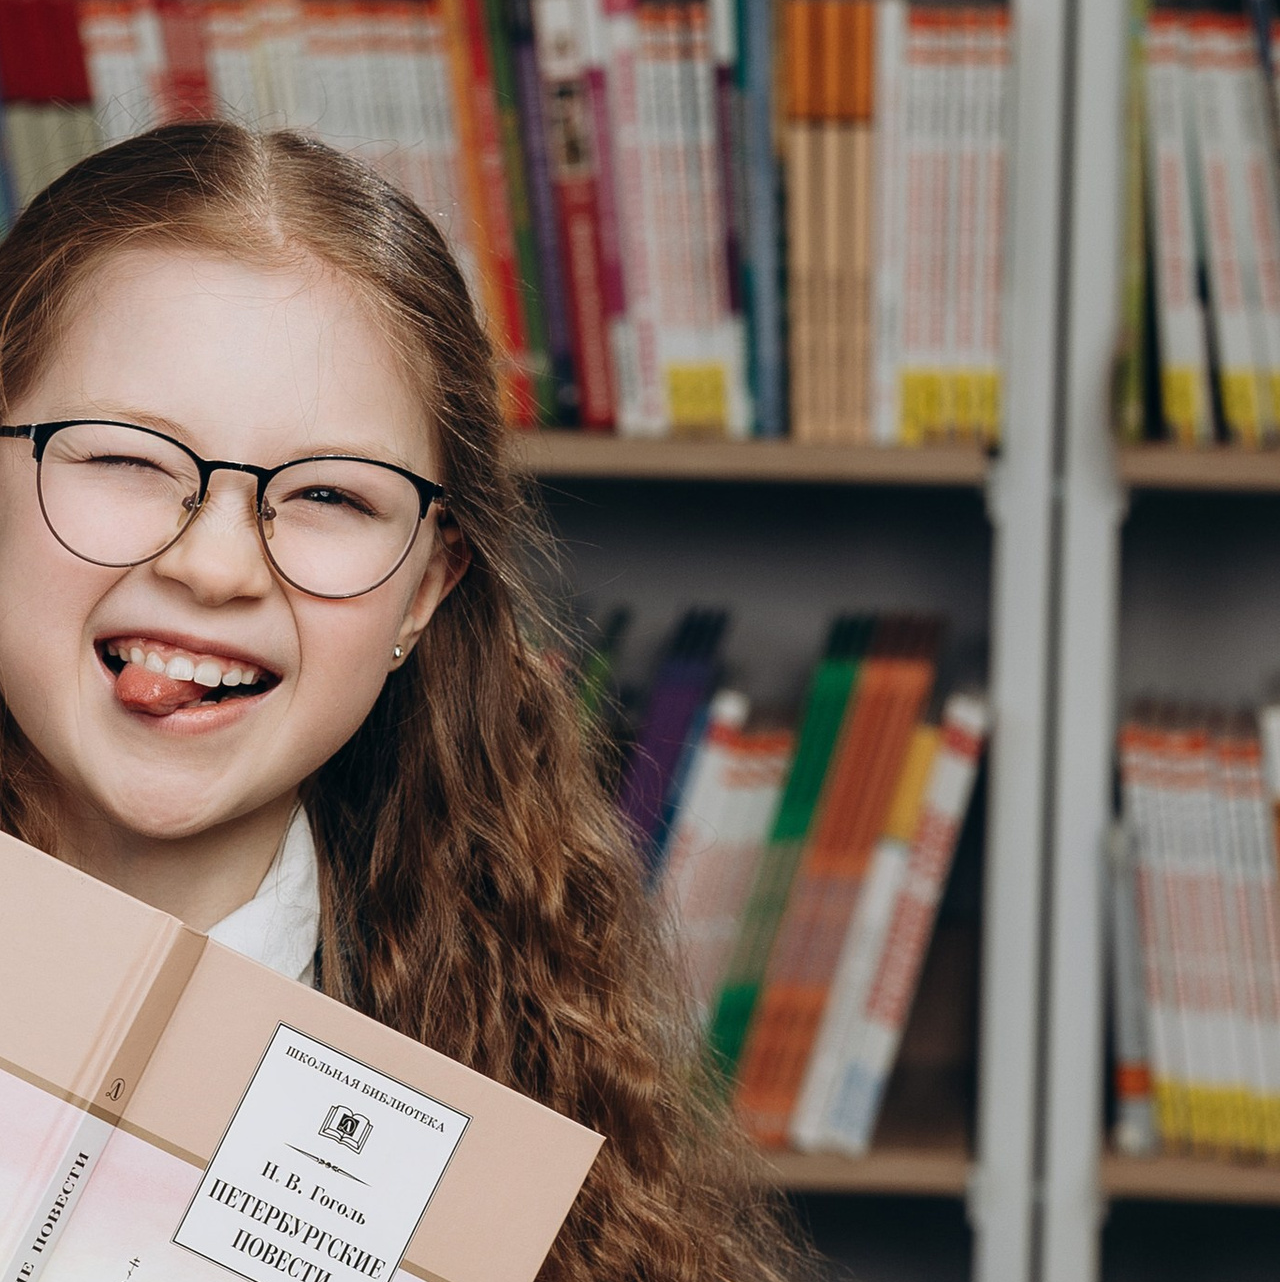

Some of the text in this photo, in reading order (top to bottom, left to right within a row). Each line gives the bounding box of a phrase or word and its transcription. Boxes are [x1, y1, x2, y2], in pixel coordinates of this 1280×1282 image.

[284, 1045, 446, 1134] ШКОЛЬНАЯ БИБЛИОТЕКА
[31, 1151, 90, 1255] ПОВЕСТИ
[207, 1177, 387, 1281] ПЕТЕРБУРГСКИЕ
[260, 1160, 367, 1227] Н. В. Гоголь
